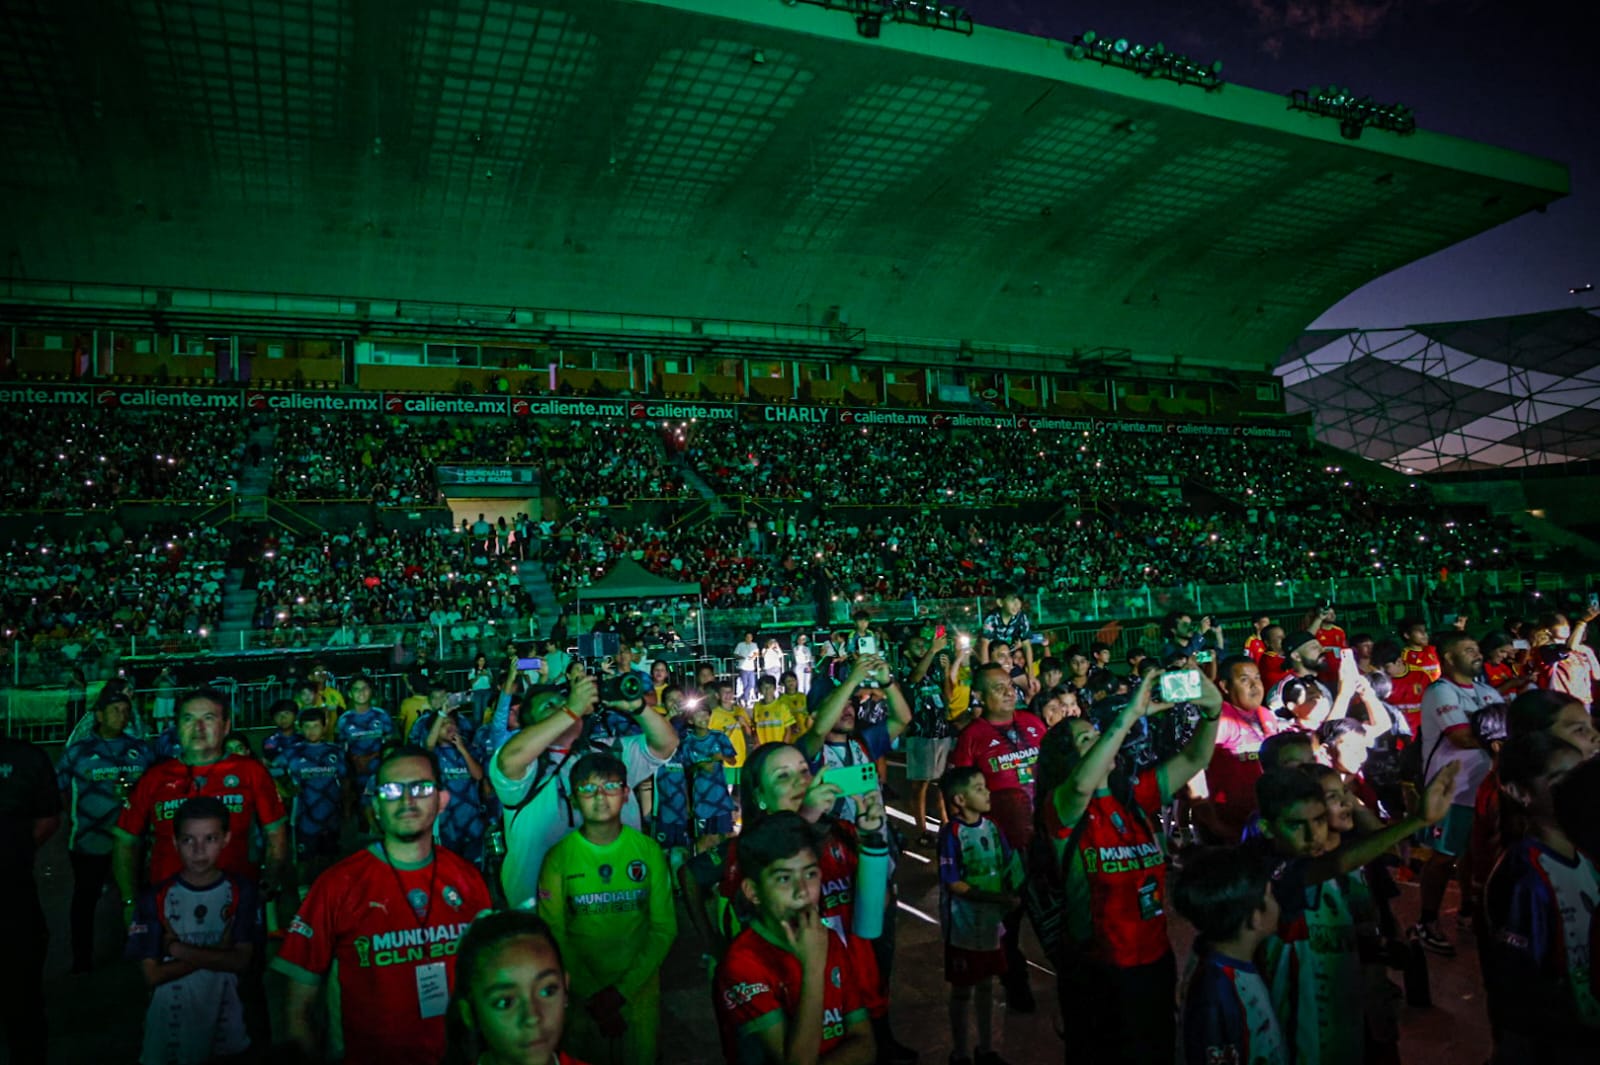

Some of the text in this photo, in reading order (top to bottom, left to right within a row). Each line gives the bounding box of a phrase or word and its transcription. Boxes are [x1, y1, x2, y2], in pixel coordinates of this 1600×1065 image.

[119, 389, 240, 408] caliente.mx
[267, 393, 378, 411] caliente.mx
[404, 397, 506, 414] caliente.mx
[530, 400, 625, 416] caliente.mx
[646, 403, 734, 419] caliente.mx
[764, 406, 829, 423] CHARLY
[853, 411, 928, 424] caliente.mx
[1028, 417, 1091, 431] caliente.mx
[1102, 859, 1141, 873] CLN
[374, 940, 460, 967] CLN 20
